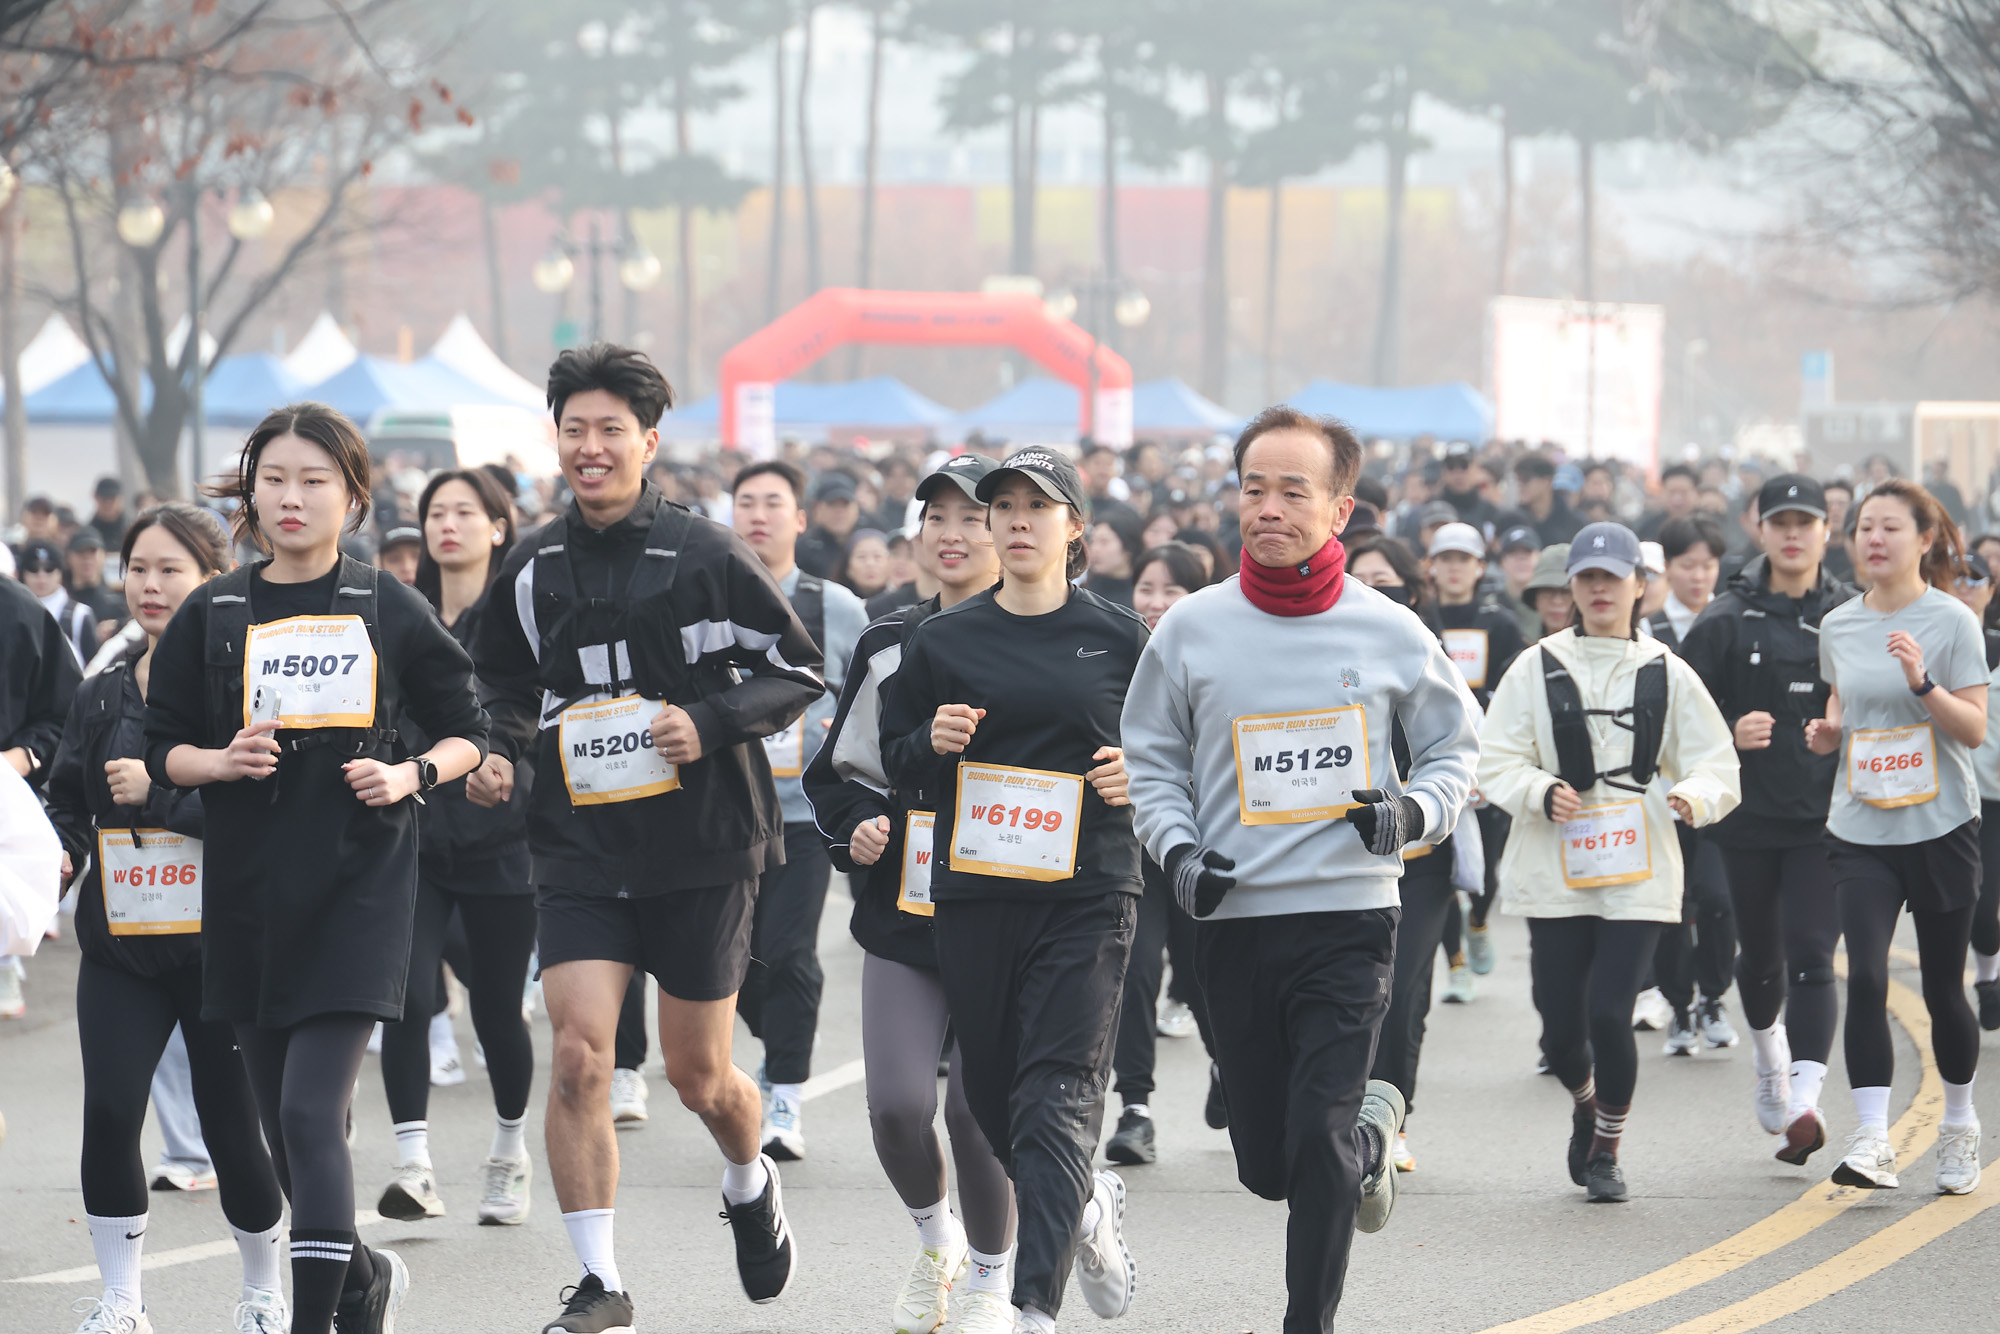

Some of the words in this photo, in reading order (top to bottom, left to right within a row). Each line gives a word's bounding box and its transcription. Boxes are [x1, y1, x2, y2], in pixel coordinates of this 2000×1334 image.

[257, 625, 294, 640] BURNING
[296, 625, 315, 633] RUN
[316, 625, 349, 633] STORY
[262, 654, 359, 677] M5007
[298, 683, 321, 693] 이도형
[594, 708, 613, 718] RUN
[613, 702, 641, 715] STORY
[1242, 721, 1284, 733] BURNING
[1286, 719, 1308, 729] RUN
[1308, 716, 1340, 728] STORY
[574, 728, 654, 758] M5206
[1254, 745, 1353, 773] M5129
[1857, 752, 1923, 773] W6266
[967, 771, 1004, 782] BURNING
[1005, 775, 1026, 785] RUN
[1025, 777, 1058, 789] STORY
[971, 803, 1062, 832] W6199
[157, 836, 186, 845] STORY
[998, 833, 1022, 845] 노정민
[1571, 829, 1636, 850] W6179
[960, 847, 977, 856] 5km
[113, 864, 197, 887] W6186
[909, 890, 924, 898] 5km
[110, 910, 126, 918] 5km
